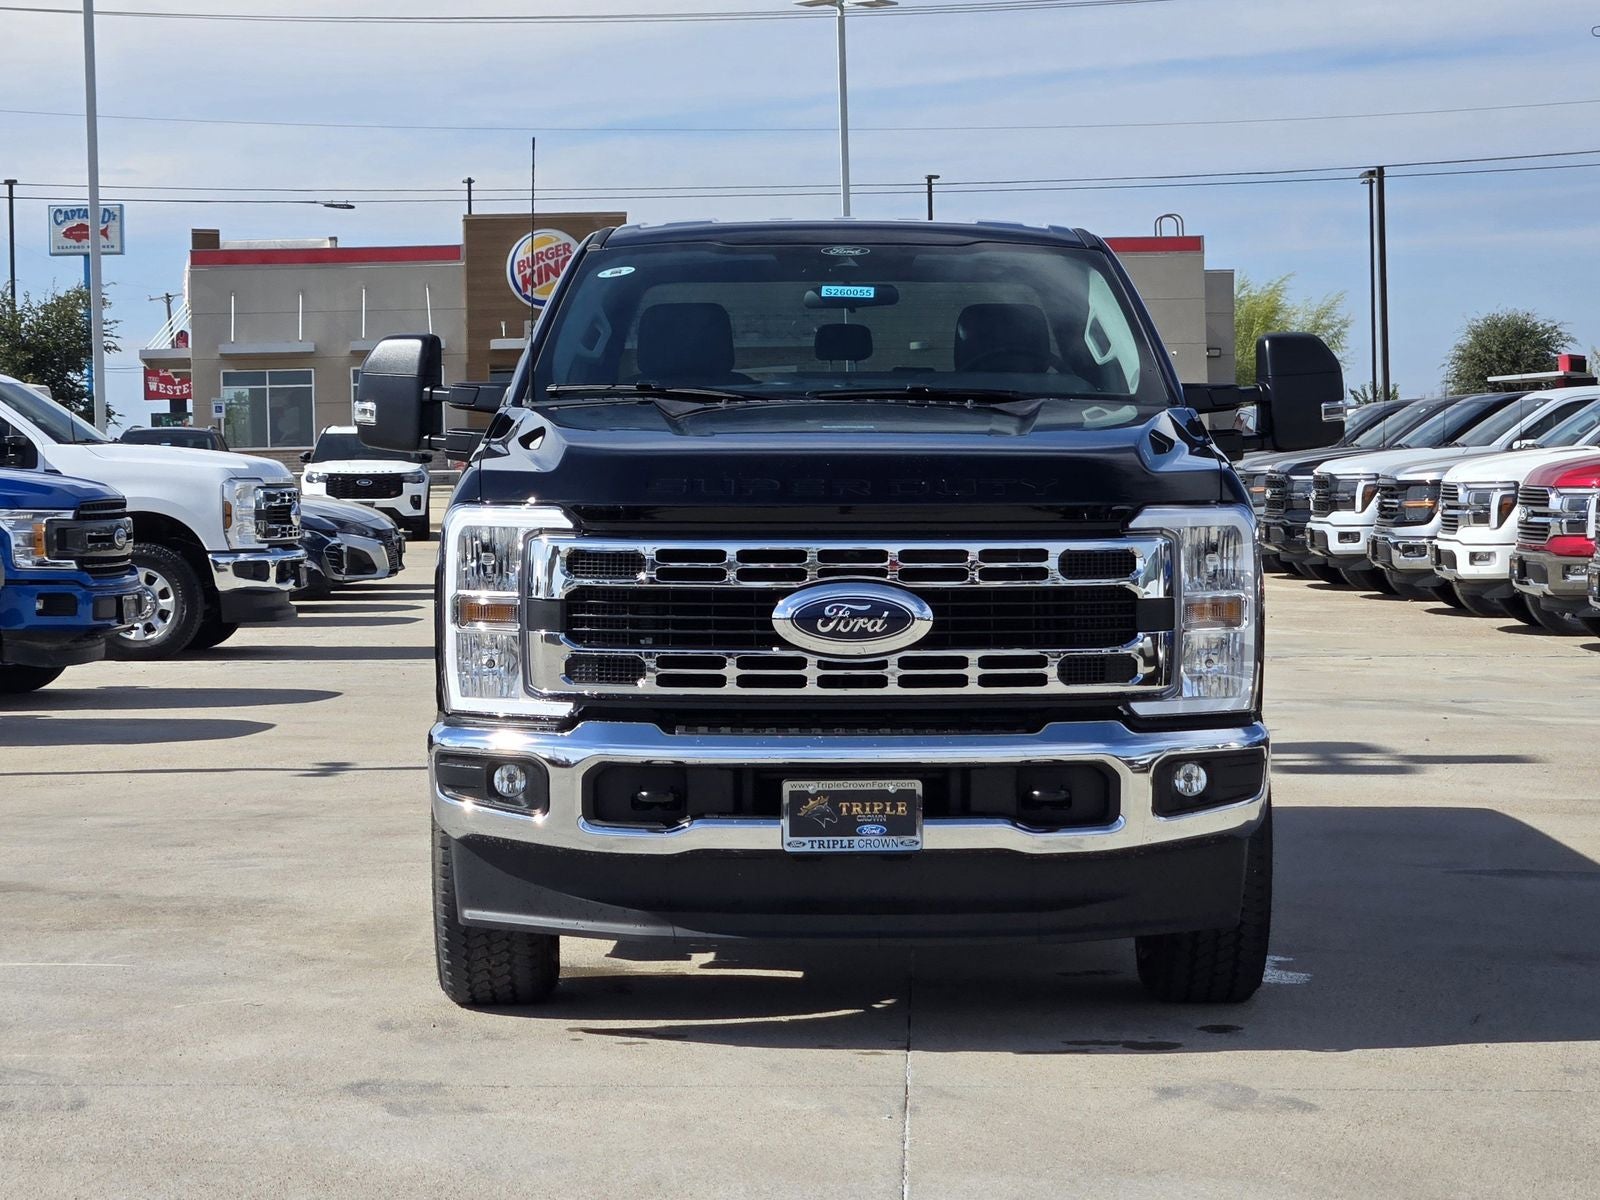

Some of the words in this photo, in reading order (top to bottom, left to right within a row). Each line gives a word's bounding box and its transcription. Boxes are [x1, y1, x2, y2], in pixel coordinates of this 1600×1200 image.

[53, 208, 99, 226] CAPTA
[517, 242, 572, 275] BURGER
[825, 288, 872, 297] S260055
[646, 477, 872, 497] SUPER
[888, 477, 1059, 497] DUTY
[816, 603, 889, 633] Ford
[790, 781, 916, 789] wwwTripleCrownFordcom
[839, 802, 908, 816] TRIPLE
[862, 826, 881, 834] Ford
[808, 840, 855, 849] TRIPLE
[858, 838, 898, 848] CROWN
